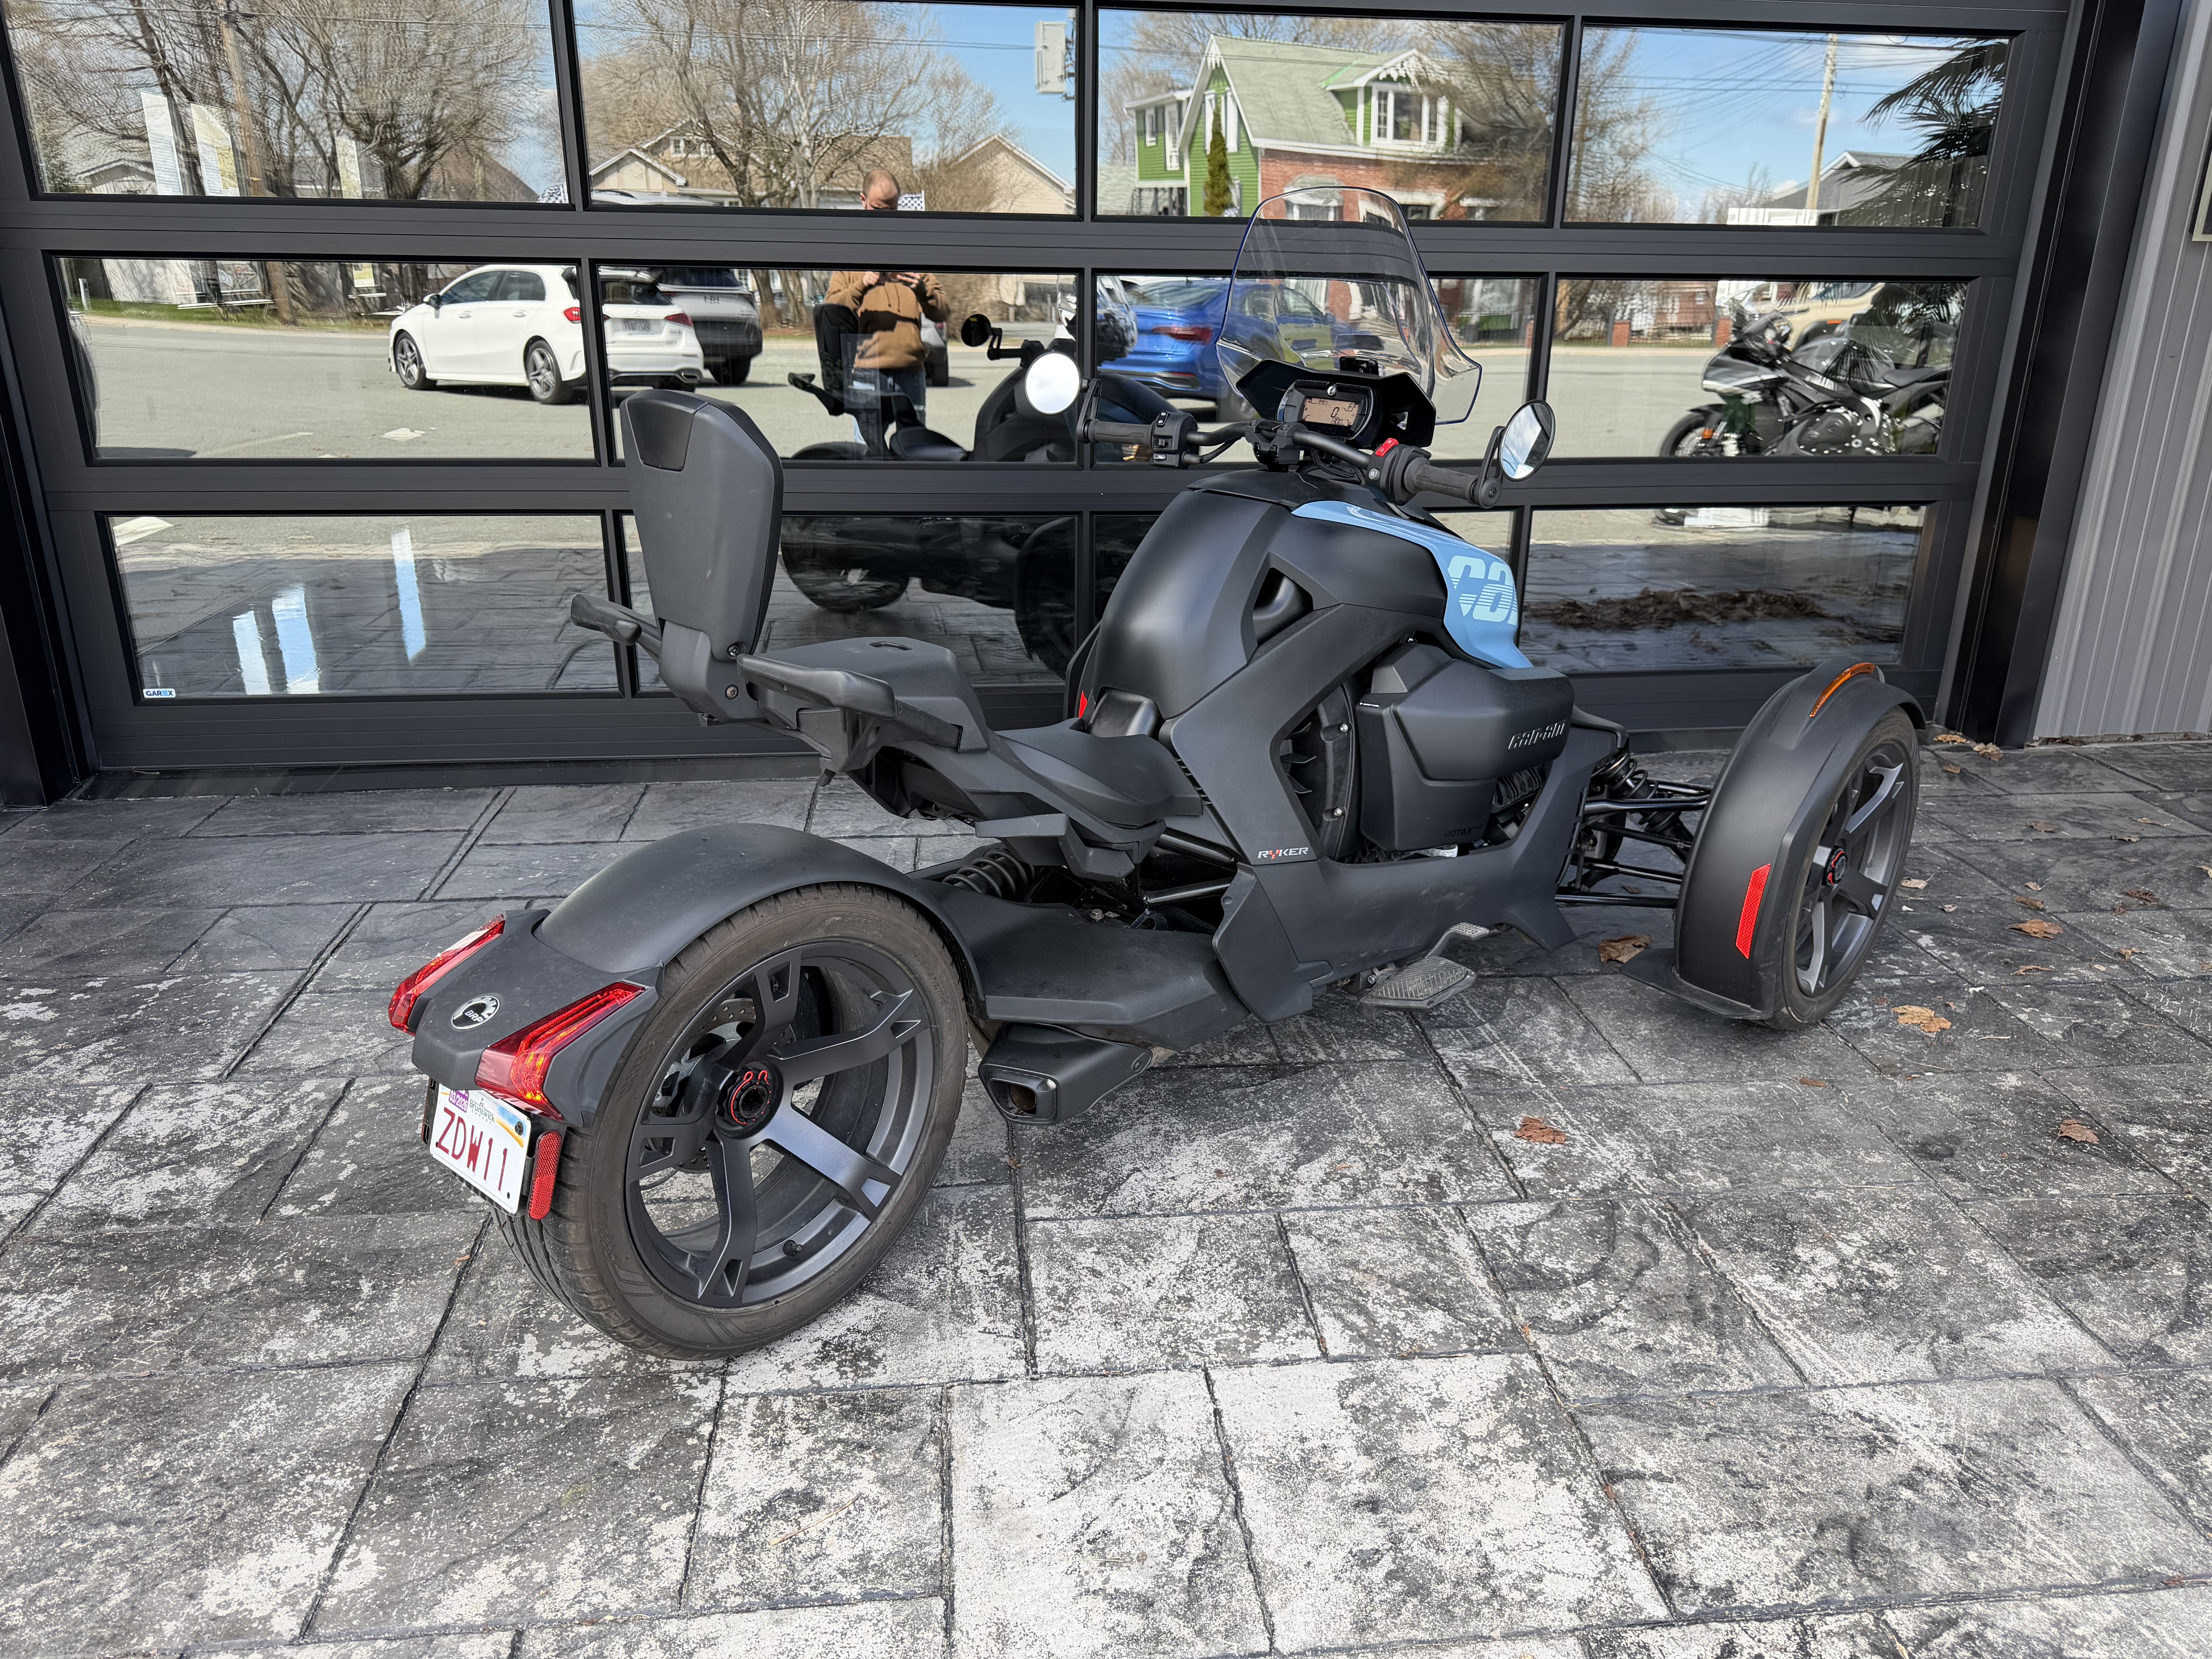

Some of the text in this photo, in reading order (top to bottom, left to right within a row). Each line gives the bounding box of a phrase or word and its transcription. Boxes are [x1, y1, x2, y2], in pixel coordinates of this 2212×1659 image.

[1331, 407, 1340, 418] 0
[1444, 827, 1474, 837] ROTAX
[1257, 847, 1309, 860] RYKER
[465, 1010, 484, 1022] BRP
[450, 1090, 468, 1111] 03/2026
[469, 1099, 495, 1123] Brunswick
[438, 1106, 508, 1192] ZDW11
